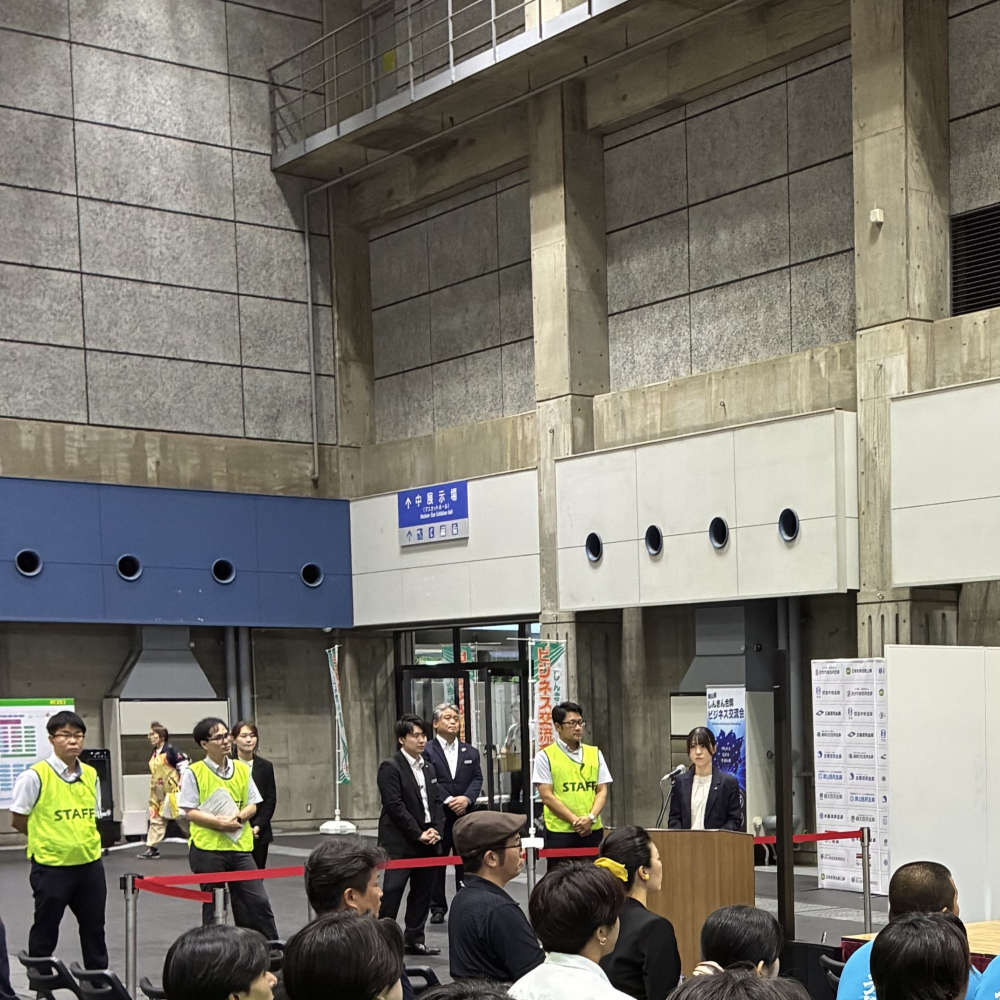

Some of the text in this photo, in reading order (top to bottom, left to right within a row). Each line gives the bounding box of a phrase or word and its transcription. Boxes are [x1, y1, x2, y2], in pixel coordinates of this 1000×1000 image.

[415, 488, 457, 507] 中展示場
[538, 647, 553, 750] ビジネス交流
[708, 708, 744, 720] ビジネス交流会
[563, 781, 596, 793] STAFF
[55, 808, 95, 821] STAFF
